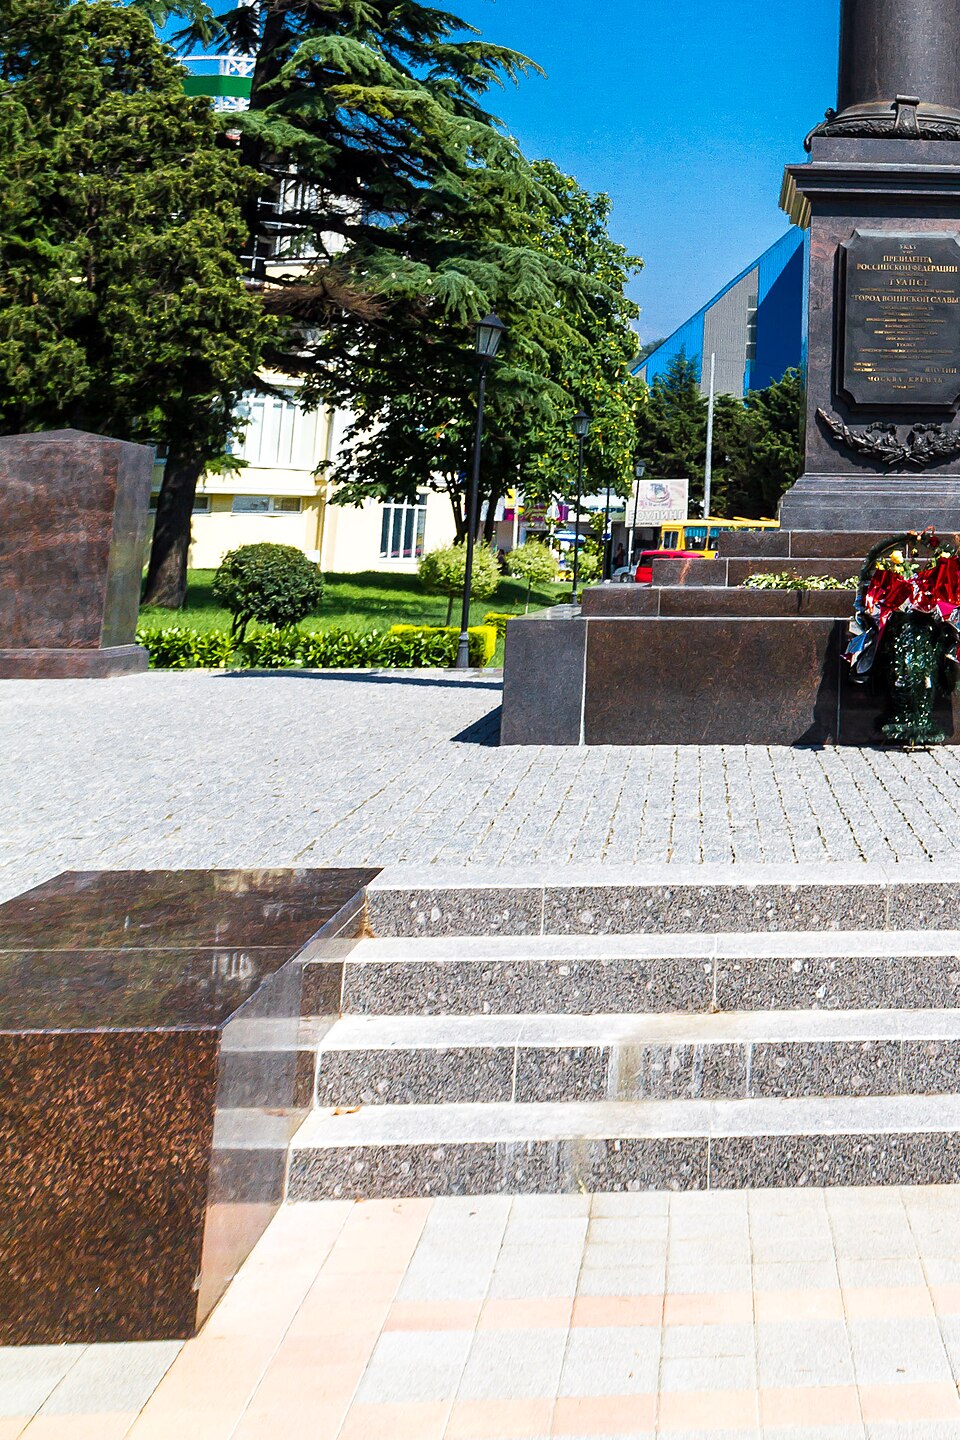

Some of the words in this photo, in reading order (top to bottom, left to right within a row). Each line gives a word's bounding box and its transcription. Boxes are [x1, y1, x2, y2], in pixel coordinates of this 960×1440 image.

[883, 255, 932, 263] ПРЕЗИДЕНТА
[856, 263, 910, 272] РОССИЙСКОЙ
[911, 264, 959, 273] ФЕДЕРАЦИИ
[882, 294, 929, 304] ВОИНСКОЙ
[628, 509, 685, 521] БОУЛИНГ
